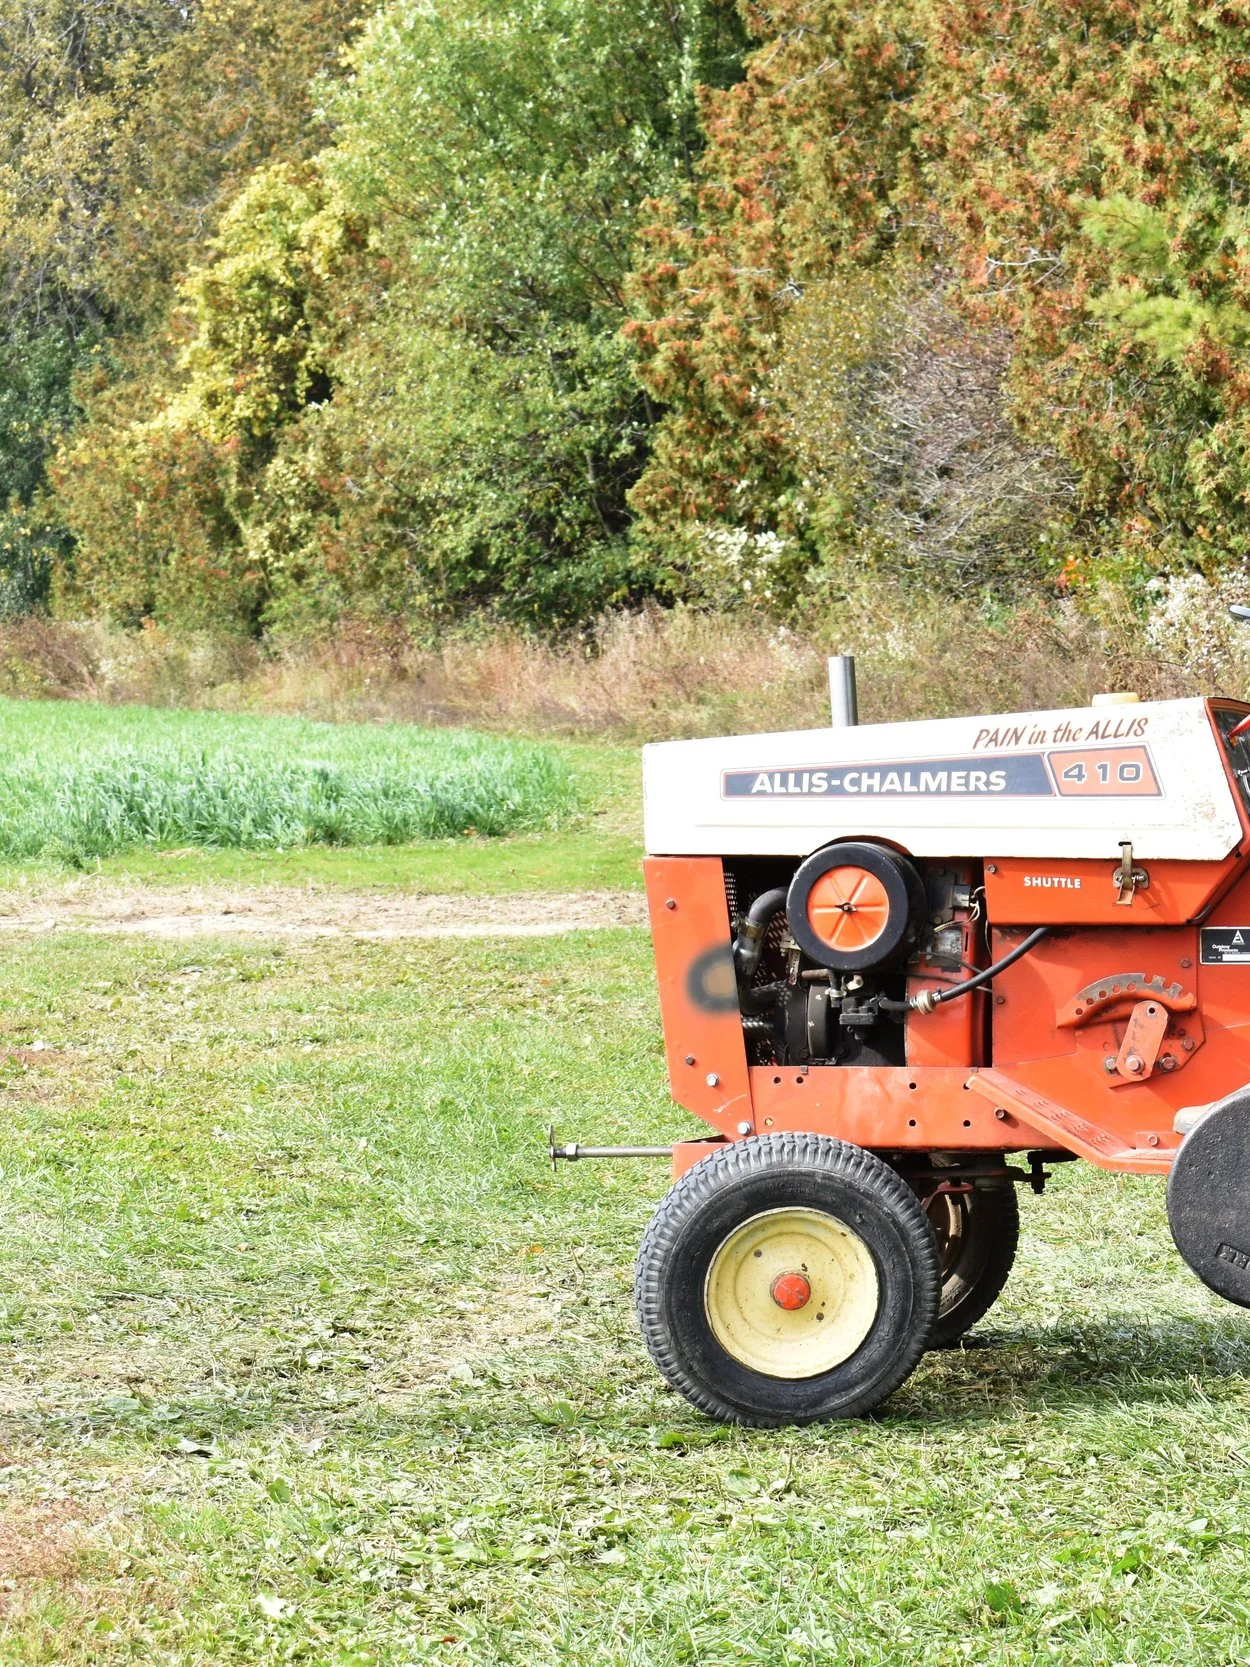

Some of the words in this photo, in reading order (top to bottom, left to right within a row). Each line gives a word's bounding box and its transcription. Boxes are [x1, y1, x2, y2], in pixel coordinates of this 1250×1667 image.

[973, 725, 1027, 750] PAIN
[1028, 724, 1047, 745] in
[1052, 721, 1083, 744] the
[1084, 717, 1149, 742] ALLIS
[751, 770, 1007, 794] ALLIS-CHALMERS
[1062, 761, 1143, 784] 410
[1023, 876, 1081, 889] SHUTTLE
